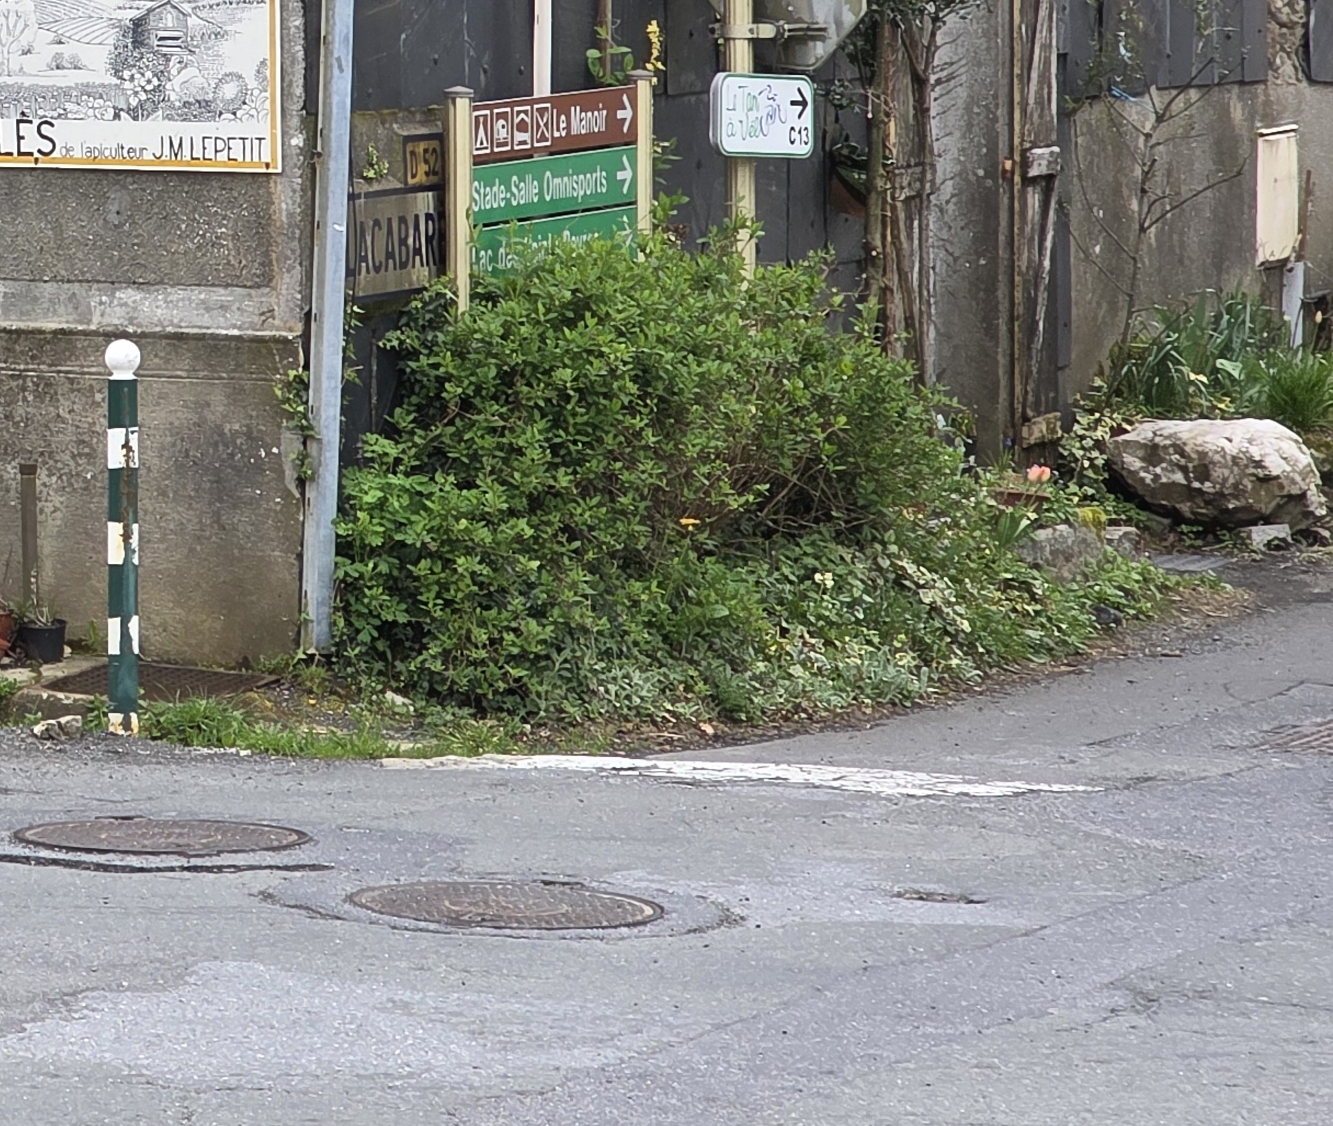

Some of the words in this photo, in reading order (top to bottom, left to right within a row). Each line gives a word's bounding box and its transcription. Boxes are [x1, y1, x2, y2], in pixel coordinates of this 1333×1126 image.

[553, 108, 567, 138] Le
[570, 103, 607, 136] Manoir
[789, 125, 810, 146] C13
[60, 141, 76, 158] de
[80, 140, 148, 161] l'apiculteur
[409, 149, 419, 180] D
[423, 147, 440, 177] 52
[472, 174, 539, 212] Stade-Salle
[543, 165, 607, 203] Omnisports
